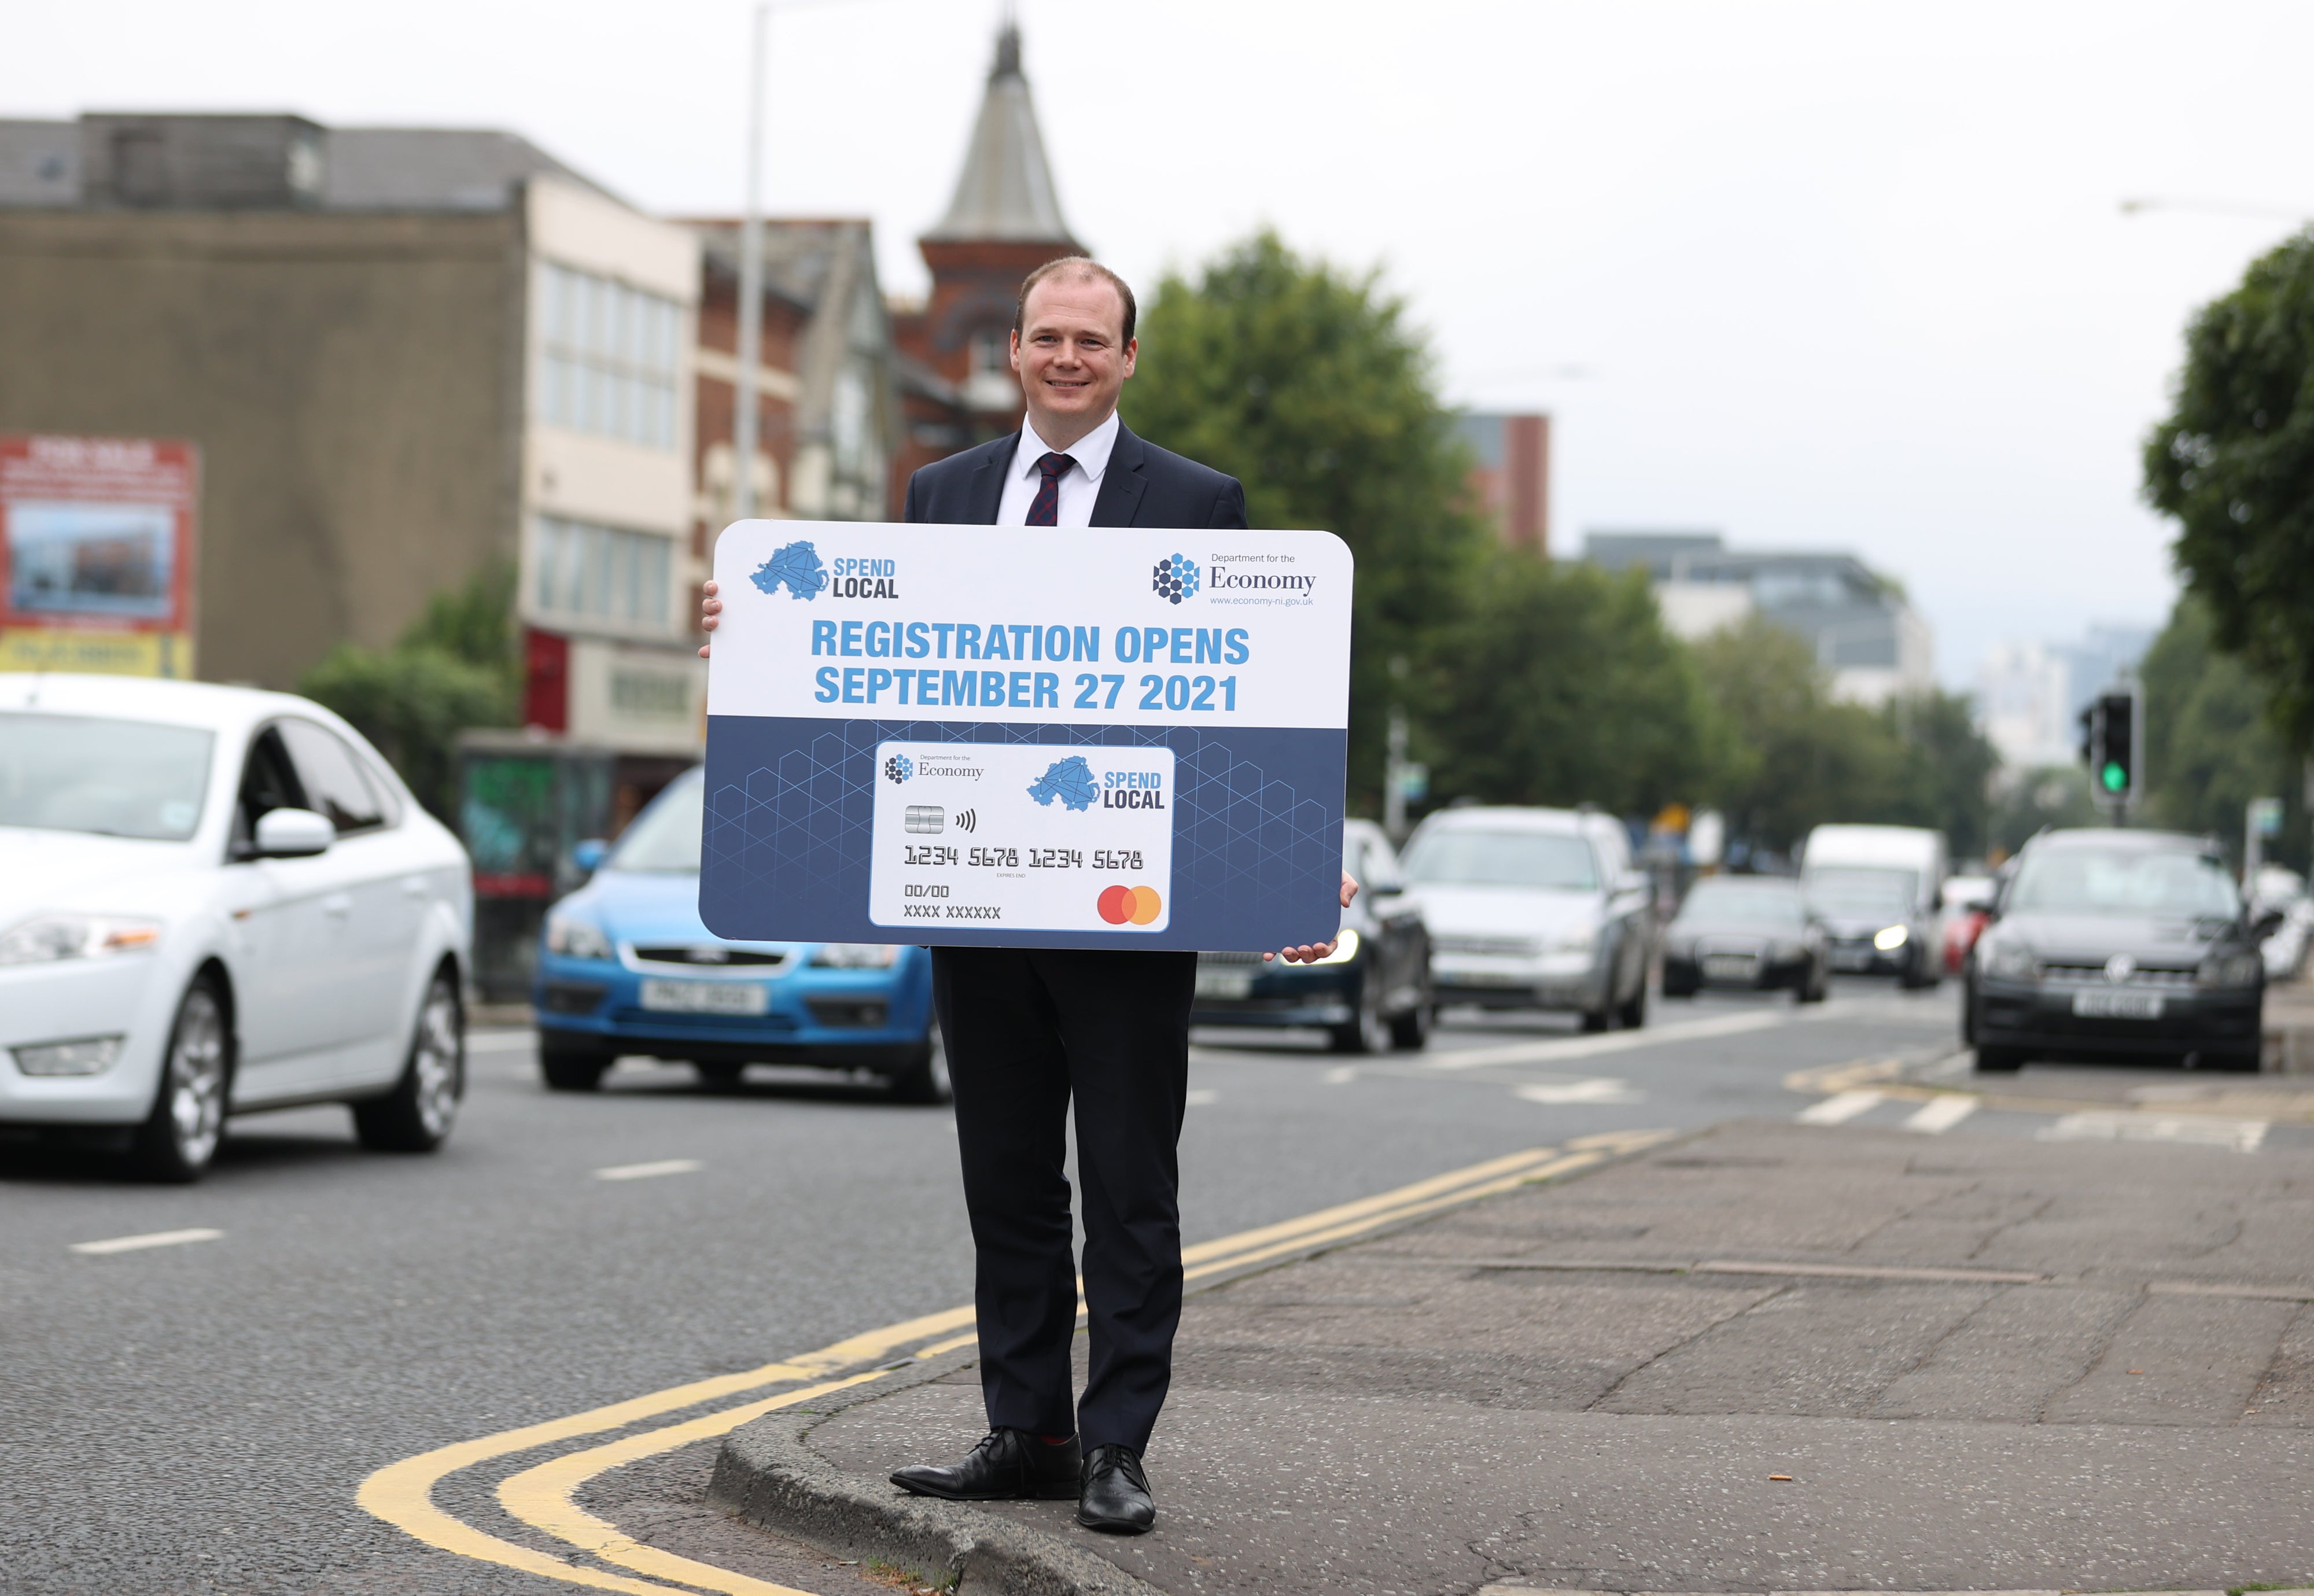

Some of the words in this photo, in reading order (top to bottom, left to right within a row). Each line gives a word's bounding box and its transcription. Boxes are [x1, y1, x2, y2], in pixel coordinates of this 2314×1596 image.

[834, 558, 894, 577] SPEND
[1212, 554, 1264, 563] Department
[1267, 554, 1278, 562] for
[833, 578, 898, 599] LOCAL
[1209, 566, 1316, 597] Economy
[1210, 597, 1313, 607] www.economy-ni.gov.uk
[812, 620, 1100, 662] REGISTRATION
[1115, 626, 1249, 665] OPENS
[815, 666, 1059, 708] SEPTEMBER
[1074, 673, 1125, 709] 27
[1138, 674, 1236, 711] 2021
[919, 762, 984, 781] Economy
[1104, 771, 1161, 788] SPEND
[1104, 790, 1165, 809] LOCAL
[904, 846, 959, 865] 1234
[968, 847, 1019, 867] 5678
[1029, 849, 1083, 868] 1234
[1092, 850, 1143, 869] 5678
[905, 884, 949, 897] 00/00
[904, 905, 940, 917] XXXX
[946, 906, 1000, 919] XXXXXX
